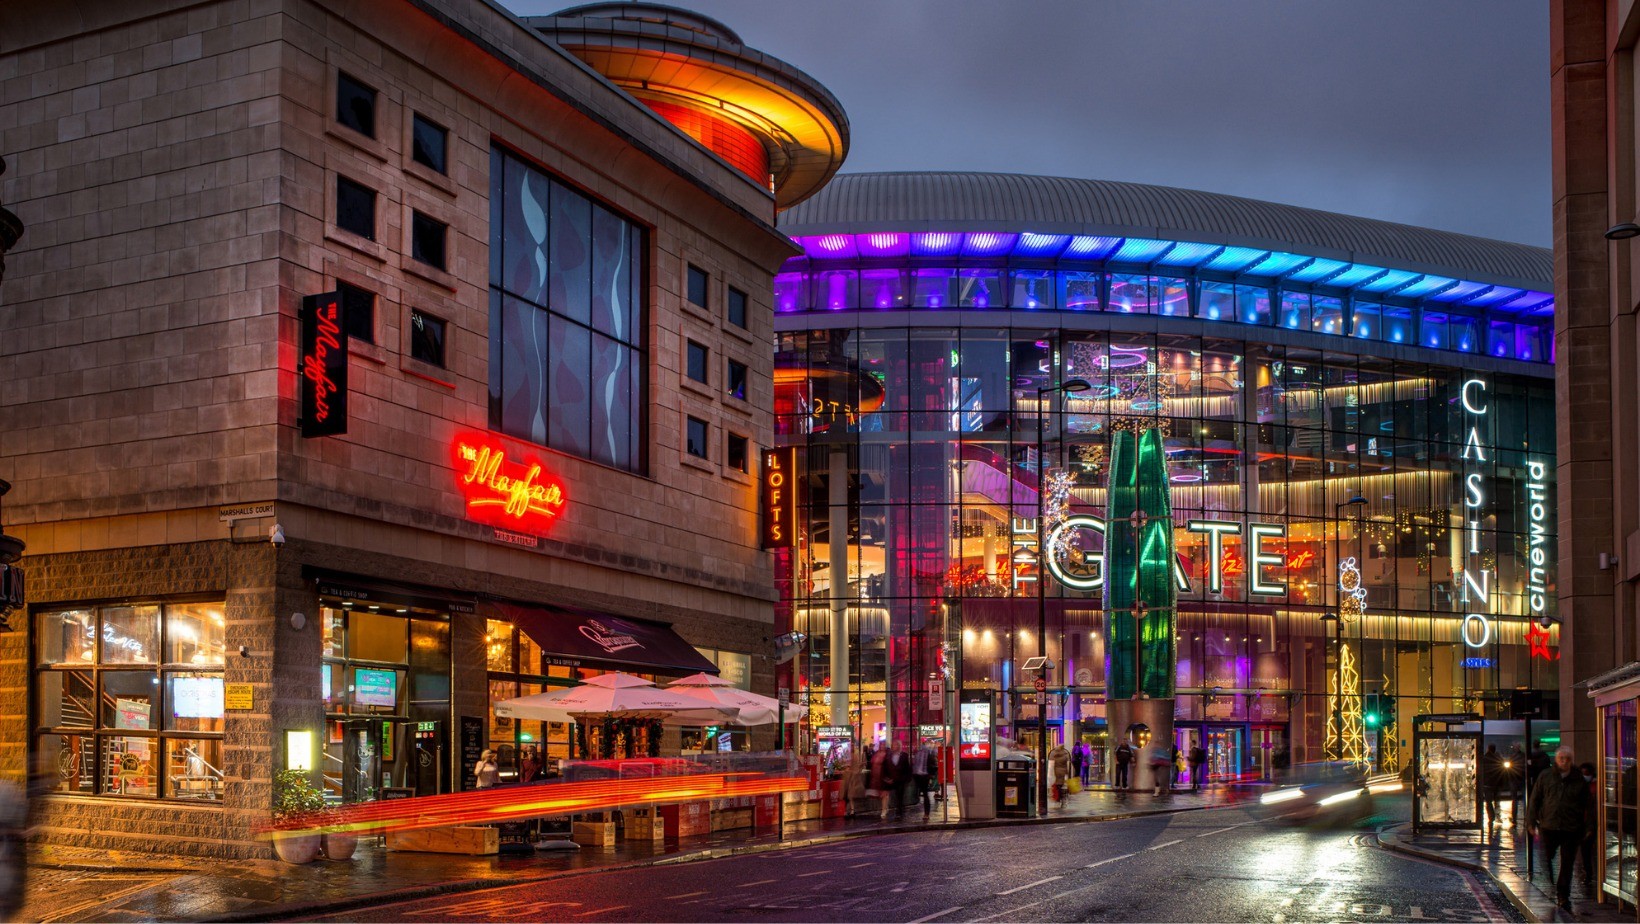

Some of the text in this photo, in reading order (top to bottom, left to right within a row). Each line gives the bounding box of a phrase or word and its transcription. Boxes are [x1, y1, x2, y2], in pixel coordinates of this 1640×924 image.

[327, 302, 338, 320] THE
[304, 307, 340, 423] Mayfair
[459, 443, 477, 462] THE
[464, 447, 564, 518] Mayfair
[220, 505, 274, 517] MARSHALLS COURT
[769, 454, 784, 541] LOFTS
[1461, 379, 1490, 648] CASINO
[1526, 461, 1545, 612] cineworld
[1012, 517, 1038, 590] THE
[1046, 514, 1287, 597] GATE
